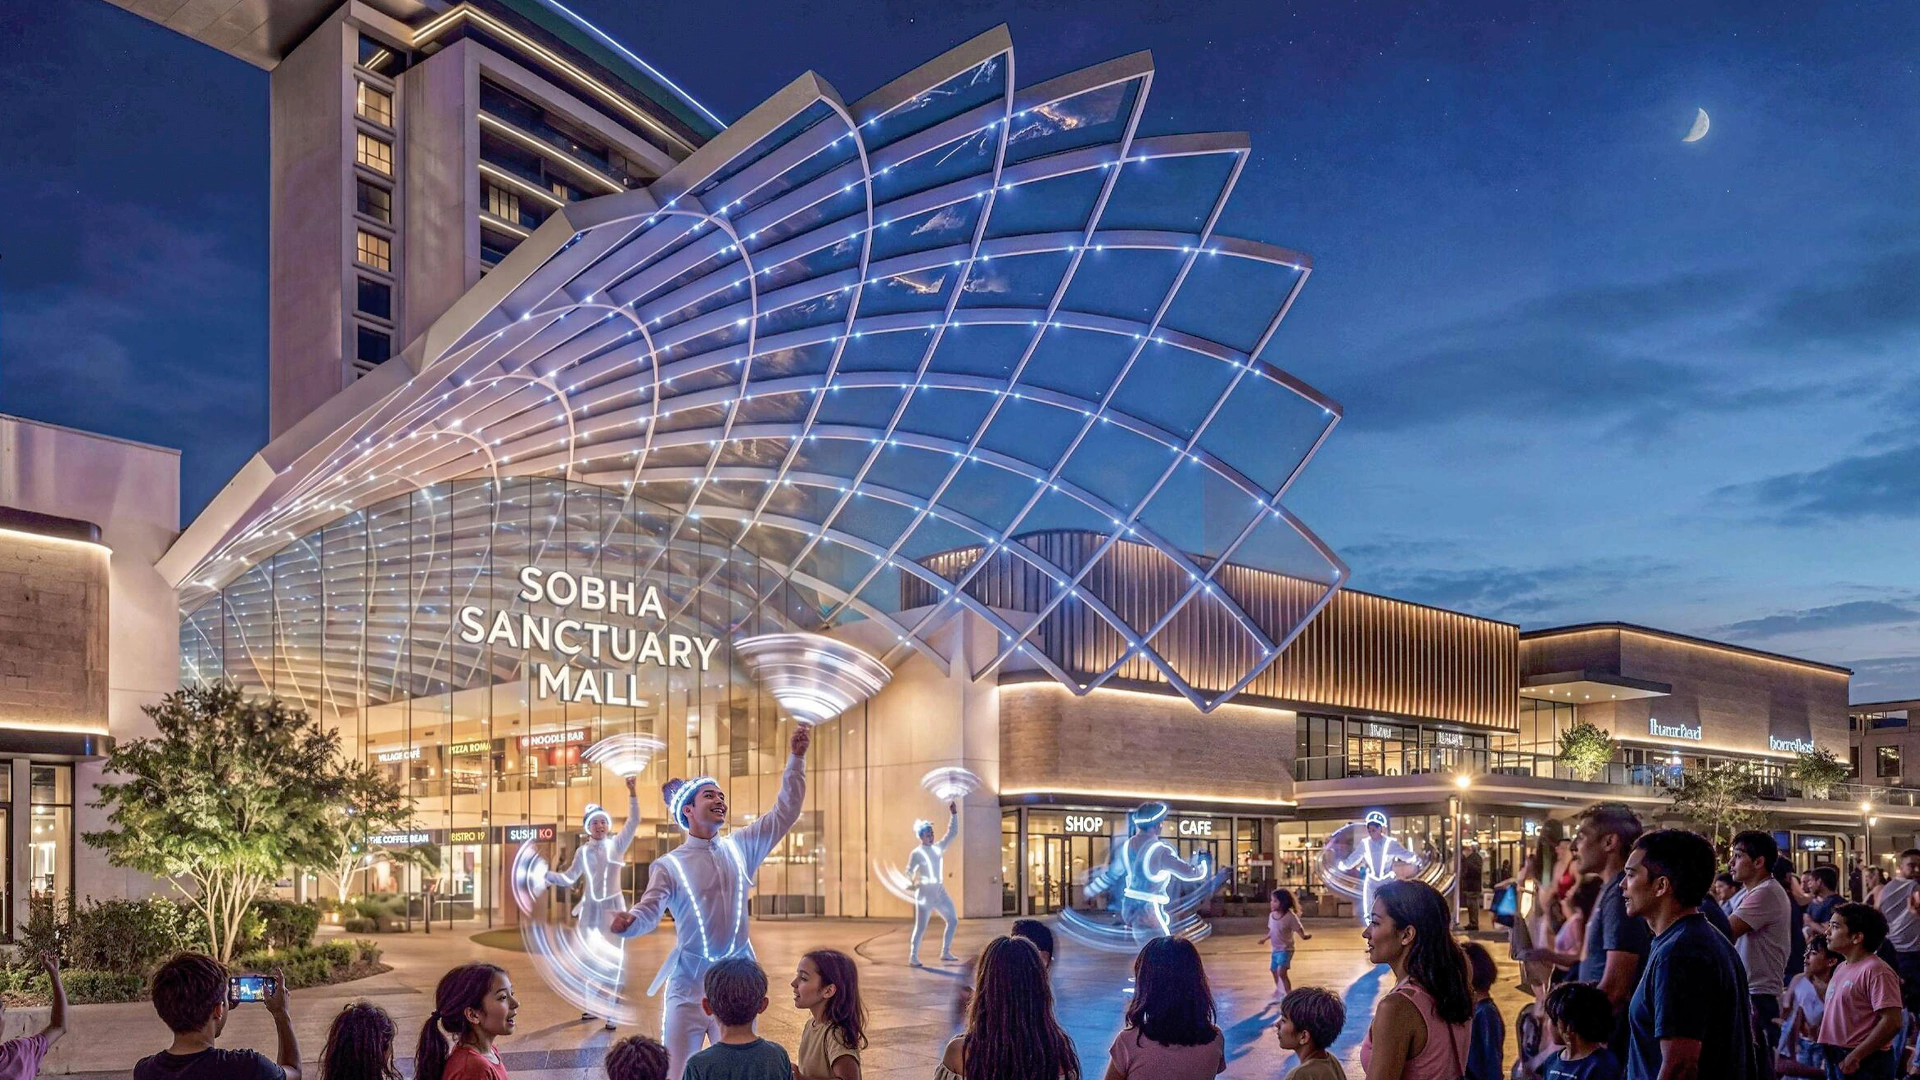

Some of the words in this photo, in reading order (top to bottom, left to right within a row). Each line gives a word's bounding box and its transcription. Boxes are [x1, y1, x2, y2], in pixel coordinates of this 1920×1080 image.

[519, 565, 667, 621] SOBHA
[459, 605, 721, 672] SANCTUARY
[537, 663, 649, 708] MALL
[531, 733, 566, 745] NOODLE
[567, 731, 584, 741] BAR
[378, 750, 403, 763] VILLAGE
[1064, 815, 1104, 833] SHOP
[1179, 819, 1212, 836] CAFE
[368, 835, 383, 844] THE
[382, 834, 409, 844] COFFEE
[409, 833, 429, 843] BEAN
[451, 831, 475, 842] BISTRO
[477, 831, 486, 841] 19
[510, 829, 537, 841] SUSHI
[539, 828, 553, 839] KO
